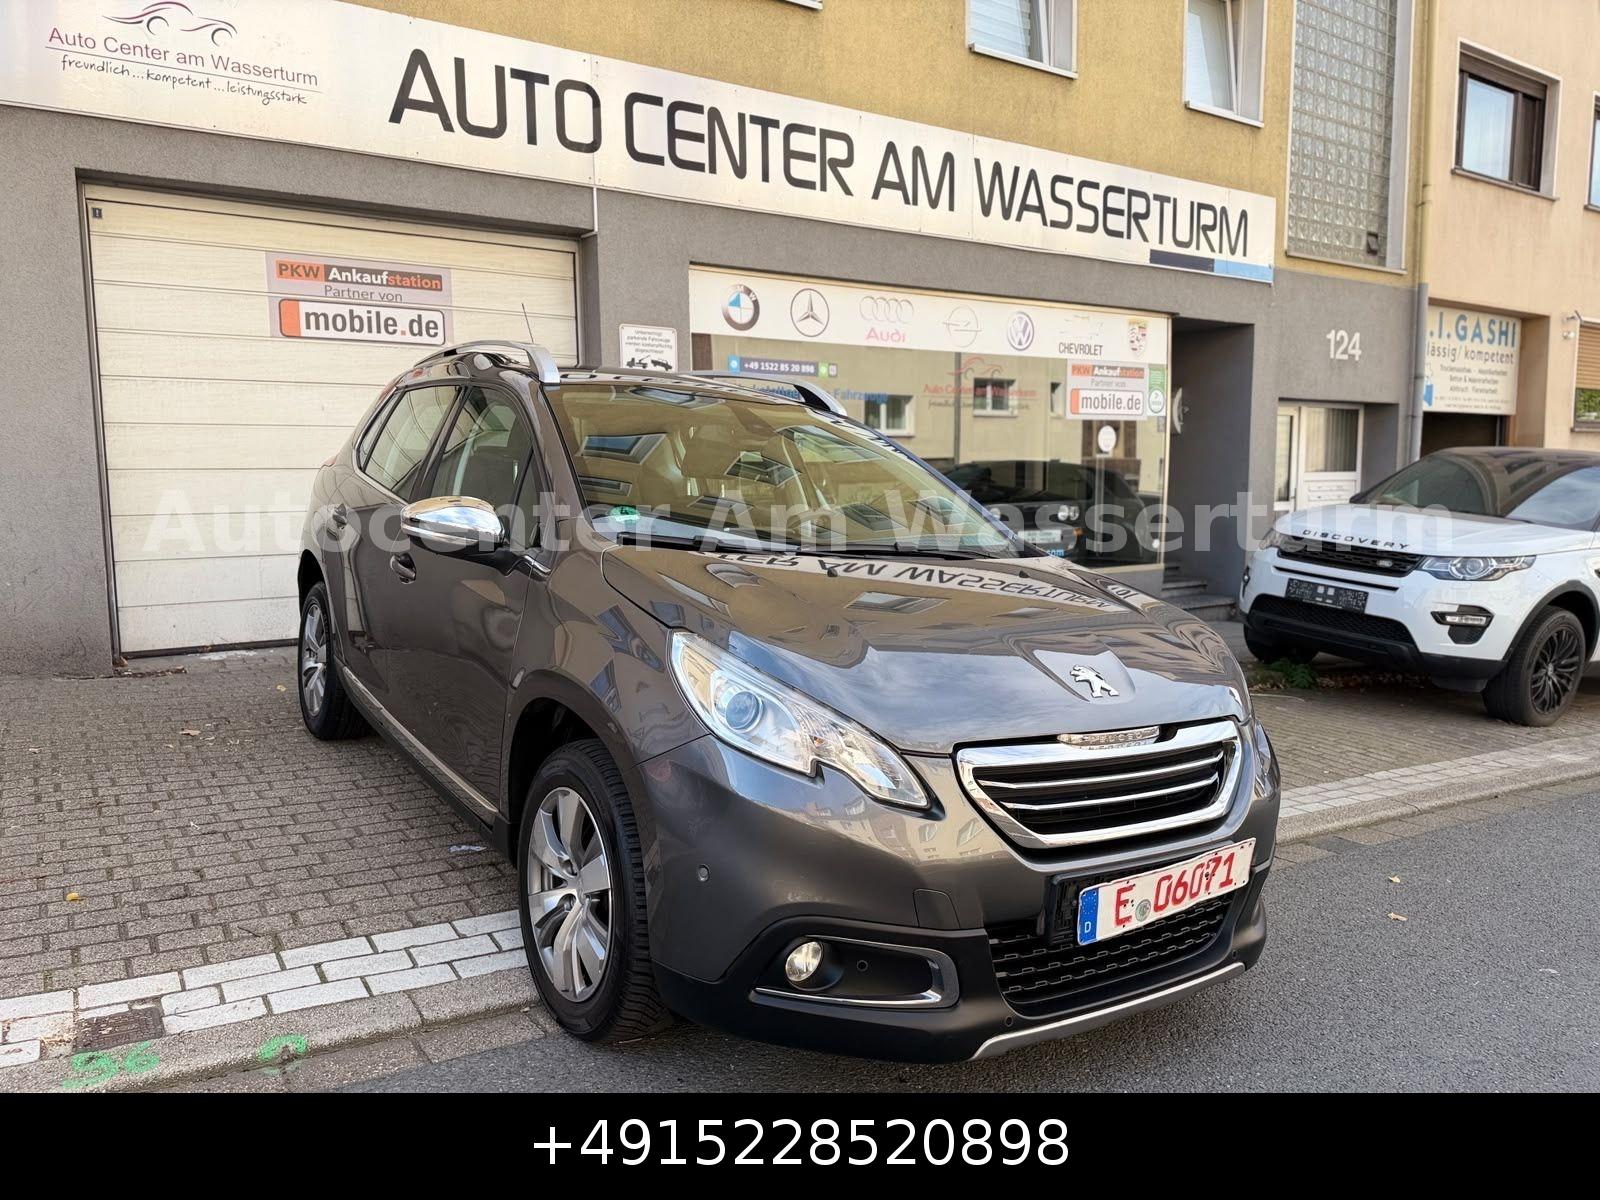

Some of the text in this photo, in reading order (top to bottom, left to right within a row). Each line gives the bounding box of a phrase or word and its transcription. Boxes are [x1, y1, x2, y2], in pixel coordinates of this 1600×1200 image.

[48, 27, 319, 86] Auto Center am Wasserturm
[388, 48, 1248, 258] AUTO CENTER AM WASSERTURM
[278, 262, 442, 289] PKW Ankaufstation
[324, 284, 403, 303] Partner von
[304, 308, 439, 338] mobile.de
[1429, 311, 1516, 348] .I.GASHI
[865, 327, 906, 343] Audi
[1326, 329, 1362, 361] 124
[1058, 341, 1104, 356] CHEVROLET
[1464, 345, 1514, 365] kompetent
[1081, 393, 1141, 410] mobile.de
[1302, 529, 1410, 549] DISCOVERY
[1115, 852, 1235, 926] E 06071
[1084, 921, 1092, 934] D
